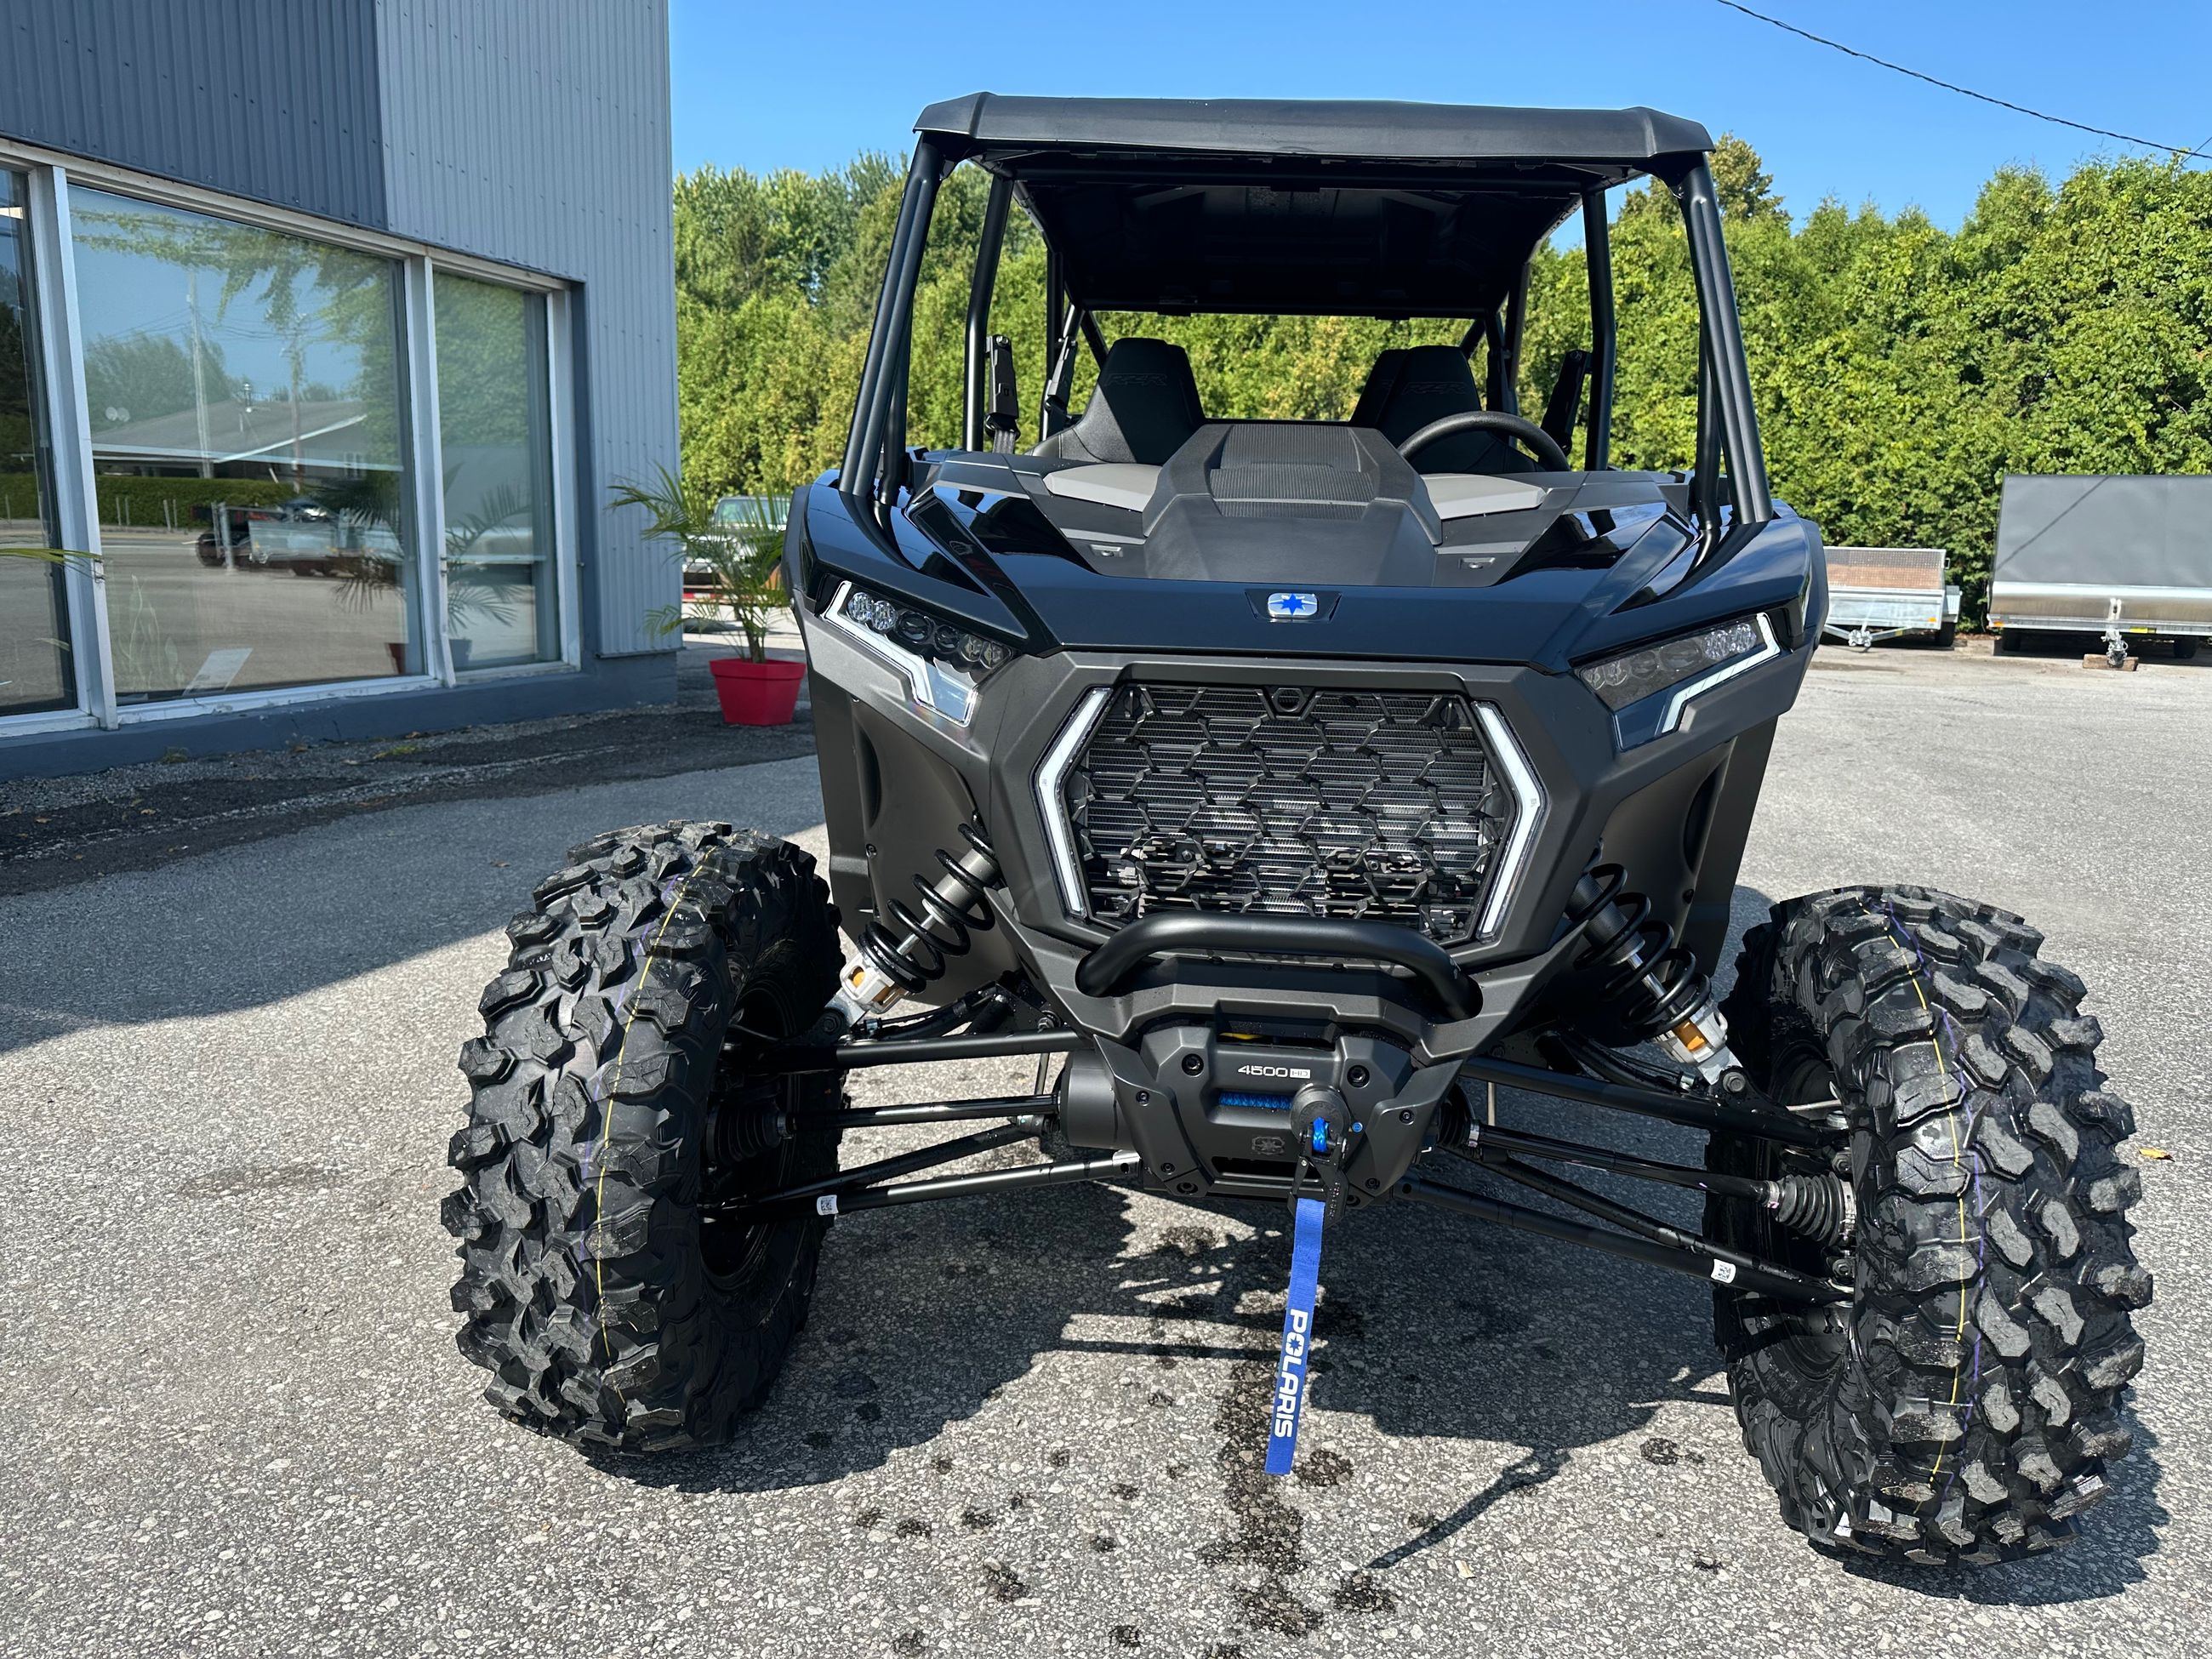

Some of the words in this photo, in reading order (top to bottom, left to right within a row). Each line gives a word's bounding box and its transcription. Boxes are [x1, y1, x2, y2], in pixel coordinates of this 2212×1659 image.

[1238, 1064, 1288, 1078] 4500
[1291, 1069, 1309, 1078] HD
[1274, 1308, 1308, 1439] POLARIS
